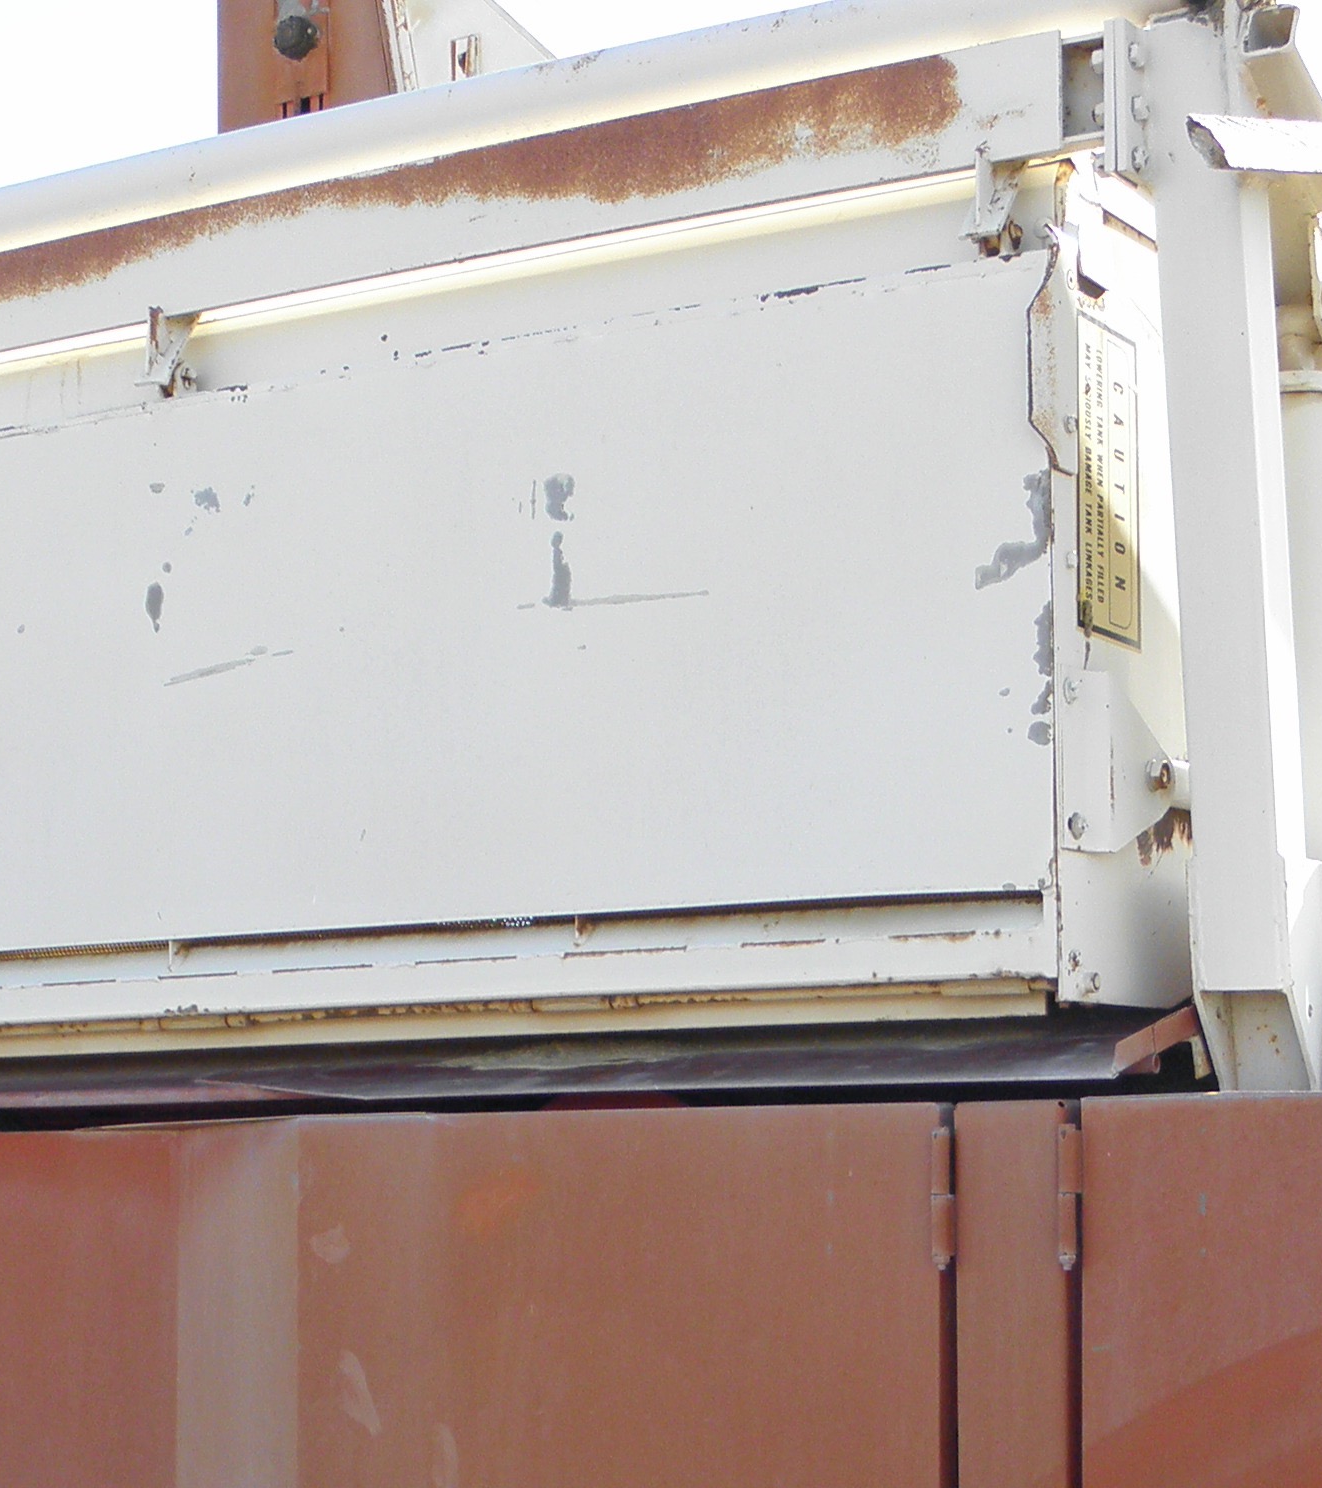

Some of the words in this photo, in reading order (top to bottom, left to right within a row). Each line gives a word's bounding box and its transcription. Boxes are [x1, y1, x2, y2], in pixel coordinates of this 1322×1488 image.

[1096, 454, 1104, 487] WHEN
[1113, 382, 1126, 591] CAUTION
[1096, 494, 1104, 558] PARTIALLY
[1097, 564, 1105, 603] FILLED
